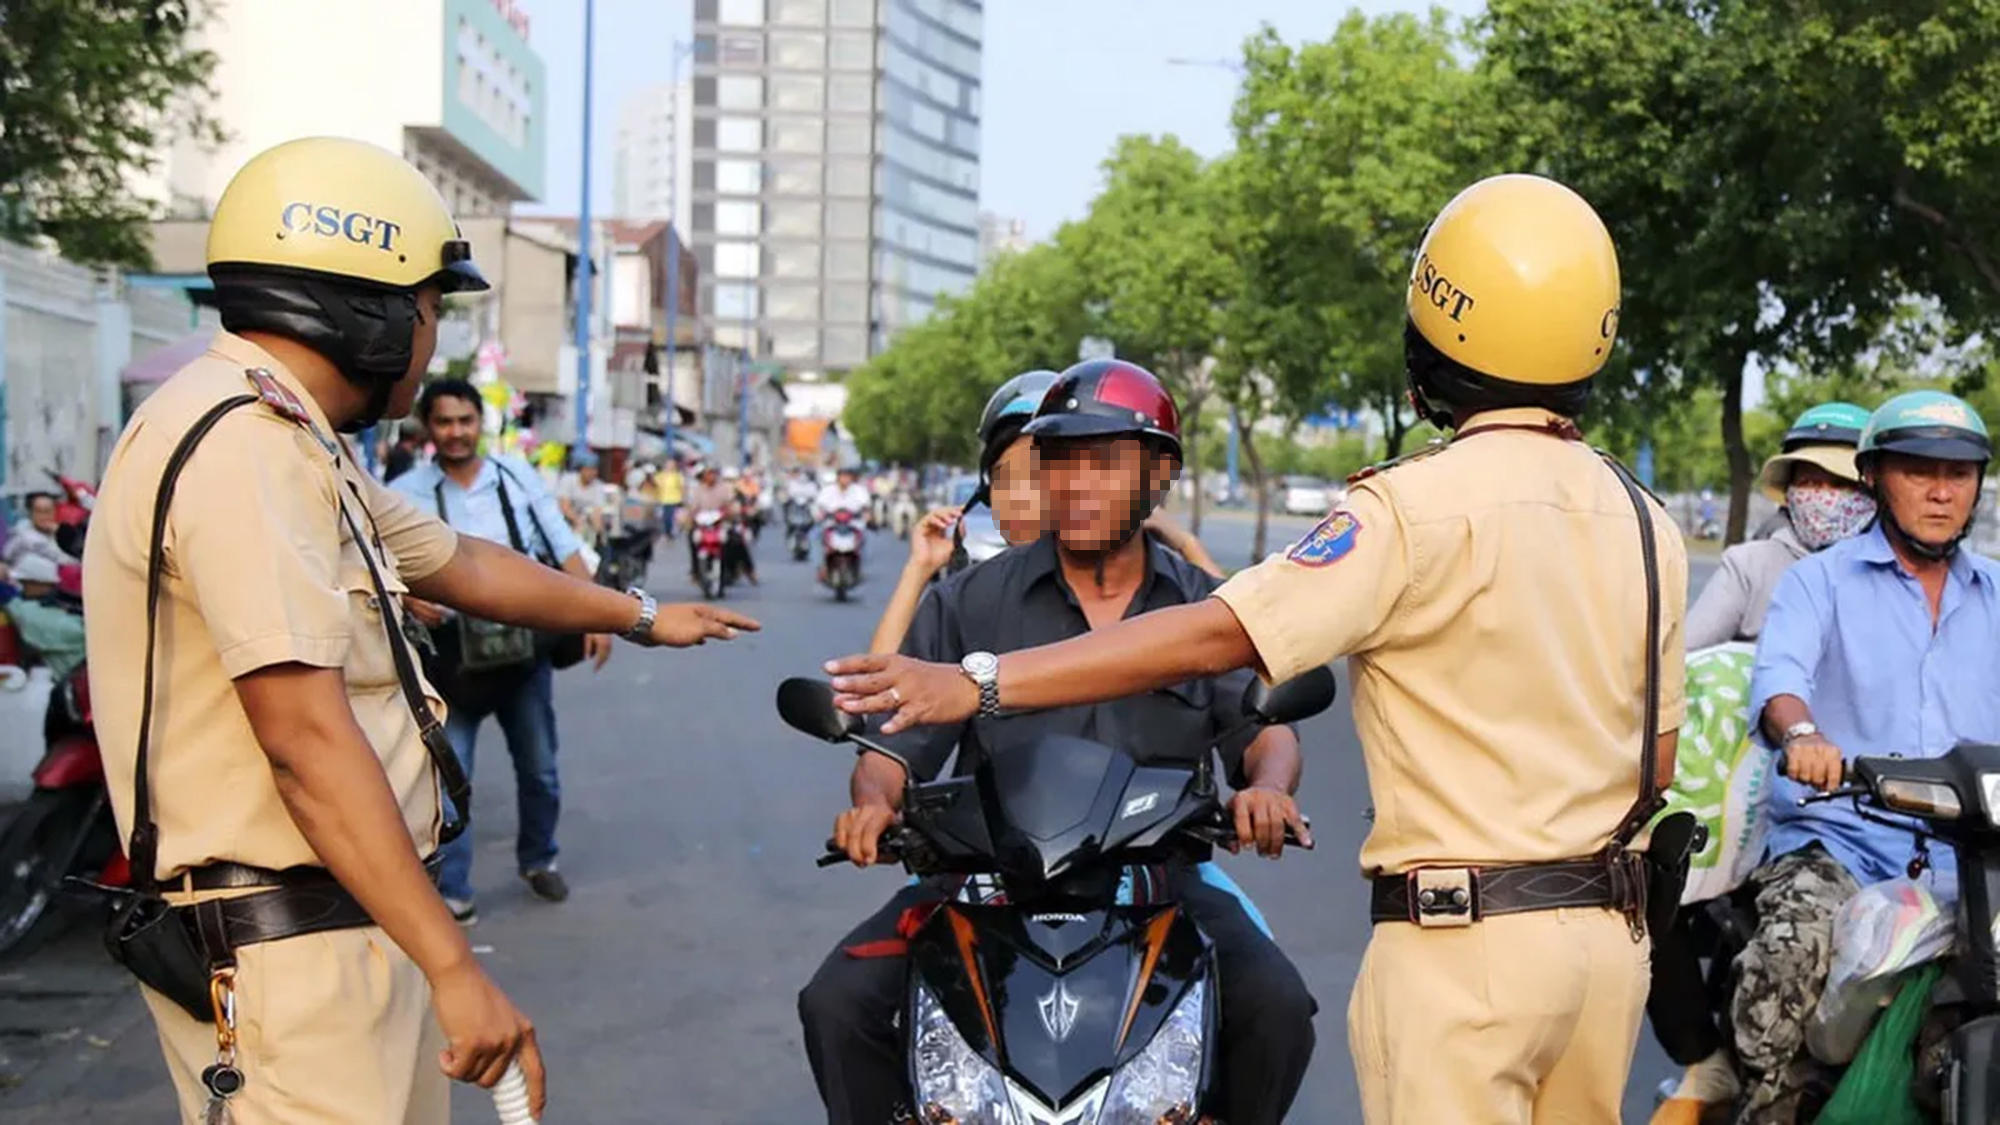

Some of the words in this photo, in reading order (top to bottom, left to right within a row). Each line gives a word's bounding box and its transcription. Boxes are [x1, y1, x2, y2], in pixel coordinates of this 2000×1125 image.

[282, 202, 401, 252] CSGT
[1415, 252, 1474, 323] CSGT
[1032, 912, 1087, 922] HONDA
